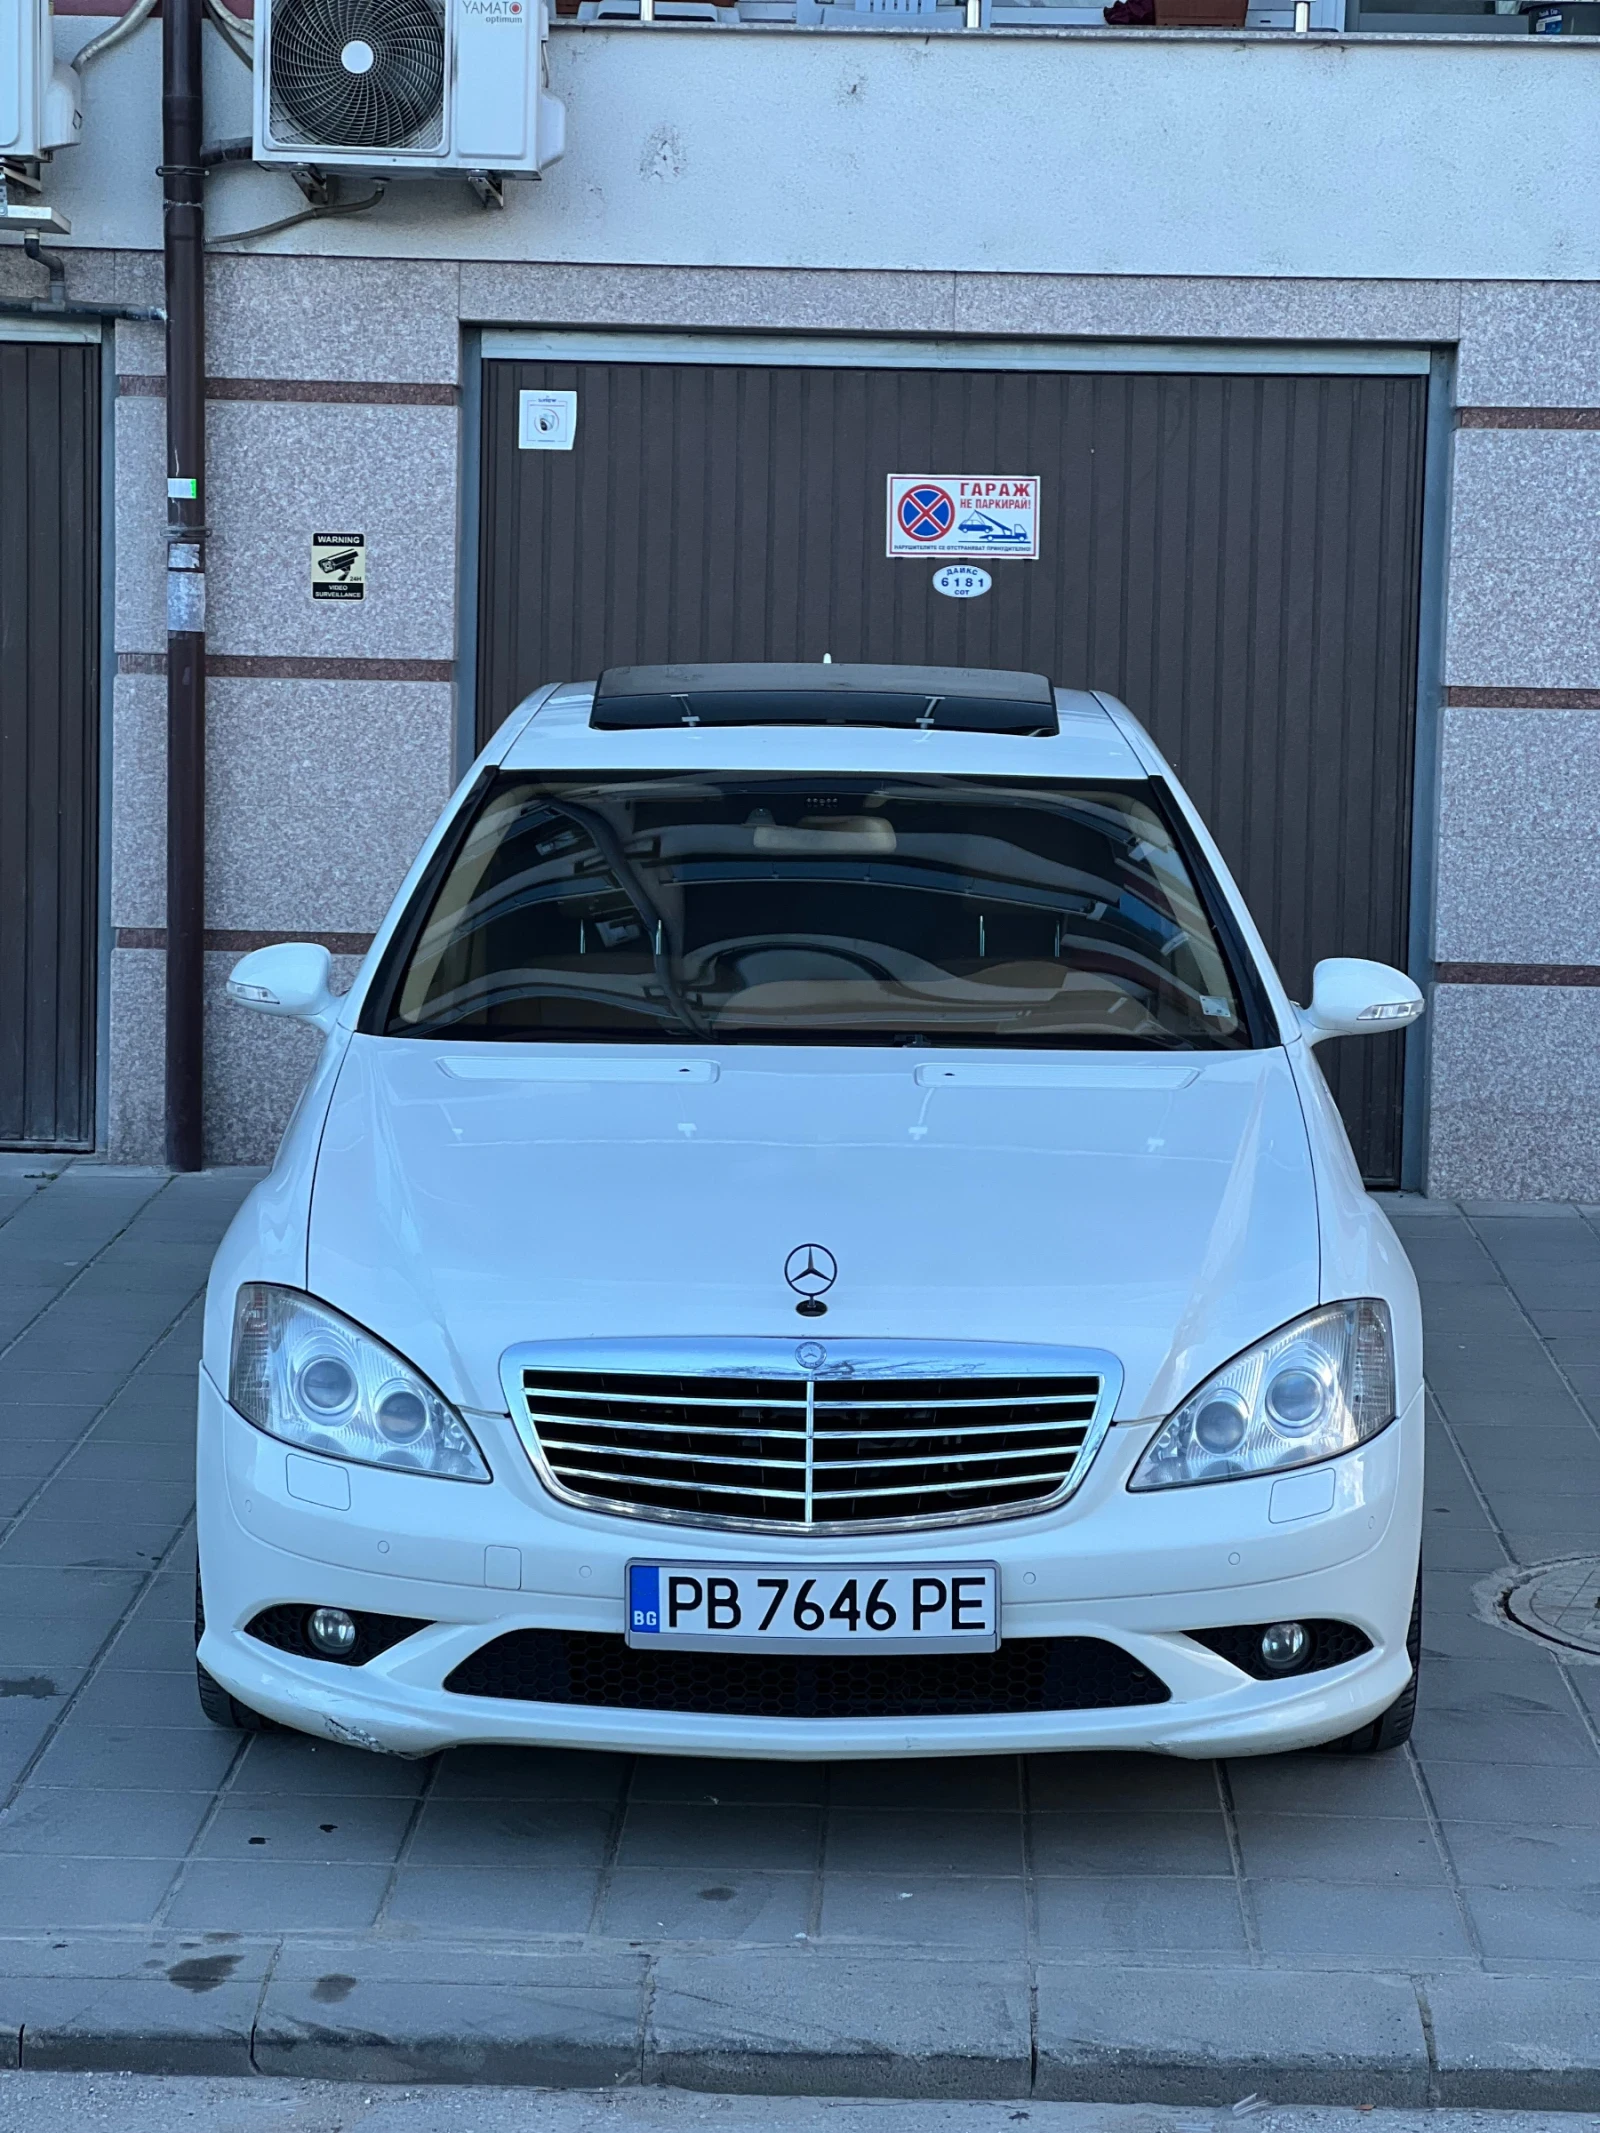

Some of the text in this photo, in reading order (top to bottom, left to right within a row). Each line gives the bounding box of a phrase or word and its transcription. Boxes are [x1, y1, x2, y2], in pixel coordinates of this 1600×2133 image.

[463, 1, 522, 15] YAMATO
[486, 16, 522, 24] optimum
[960, 482, 1031, 497] ГАРАЖ
[960, 498, 1031, 510] НЕ ПАРКИРАЙ!
[318, 536, 360, 544] WARNING
[634, 1576, 986, 1632] BG PB 7646 PE
